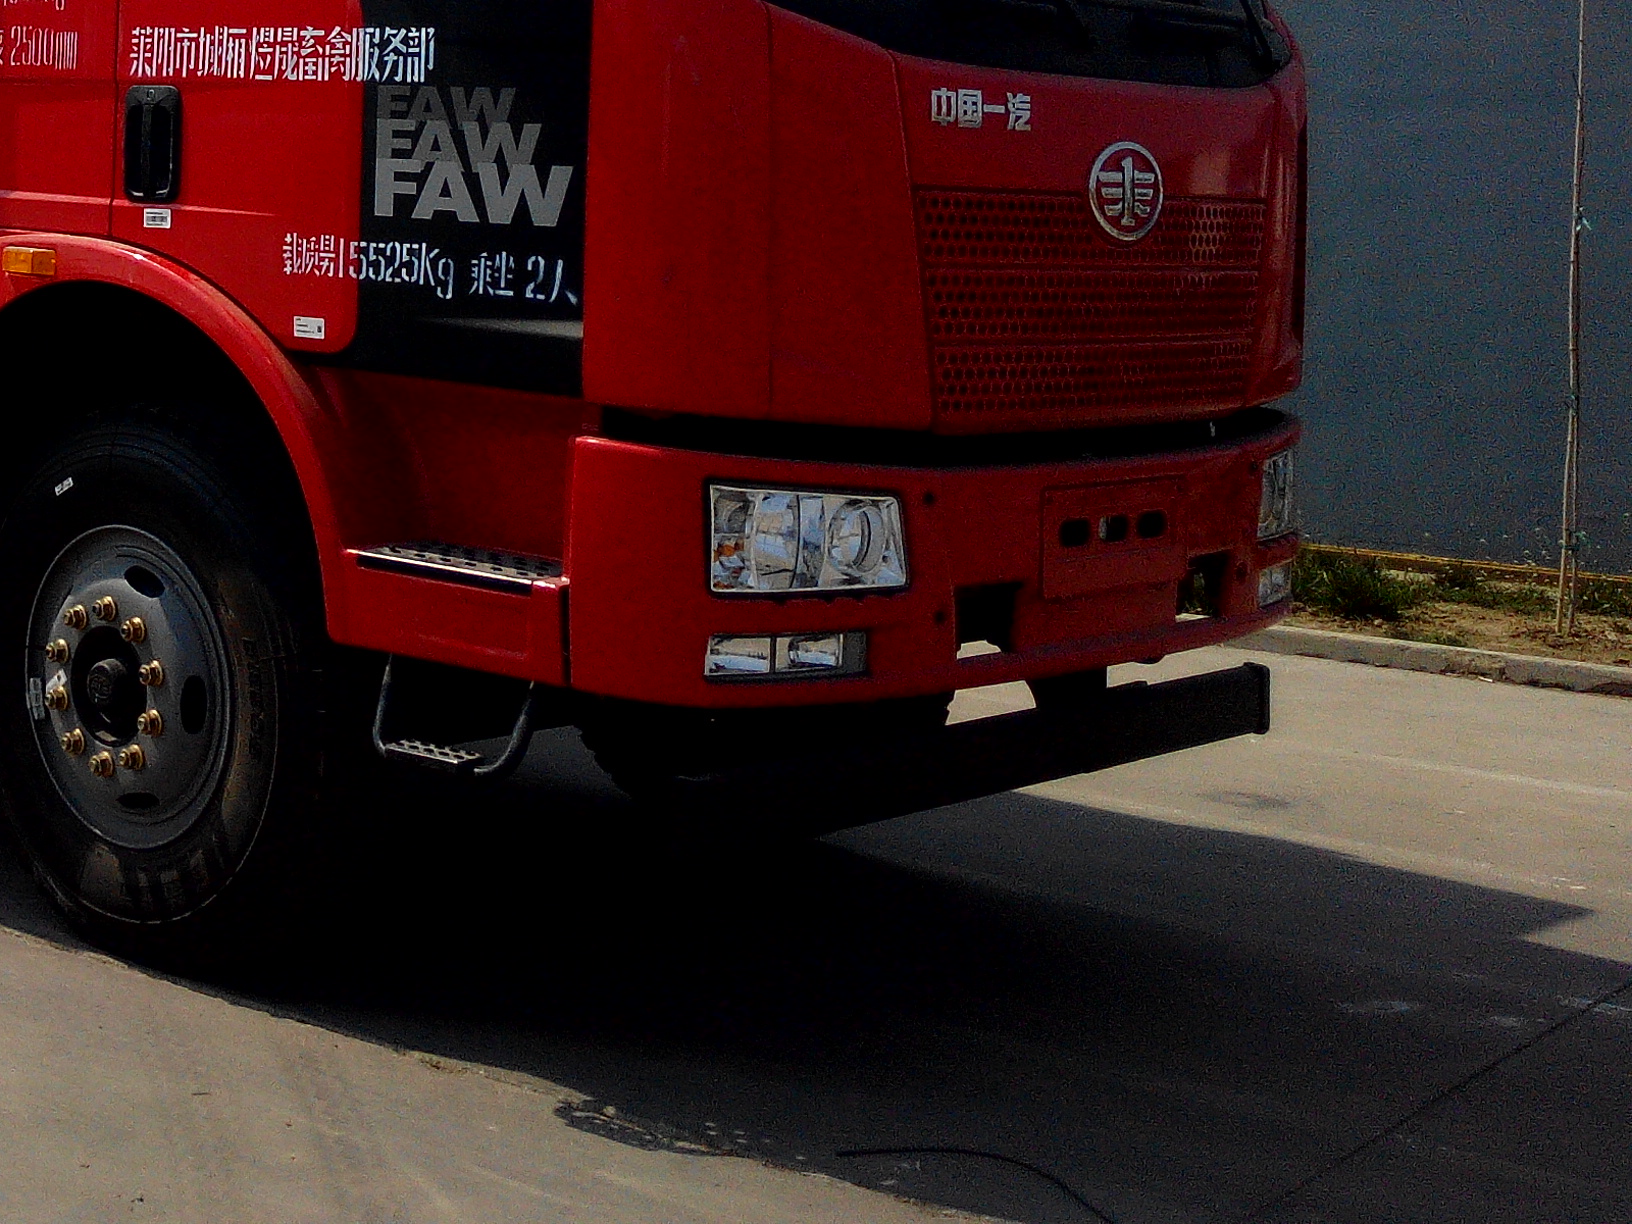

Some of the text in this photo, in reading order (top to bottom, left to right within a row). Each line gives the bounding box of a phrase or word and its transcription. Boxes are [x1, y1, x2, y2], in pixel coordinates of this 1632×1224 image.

[931, 87, 1032, 131] 中国一汽
[374, 158, 574, 227] FAW
